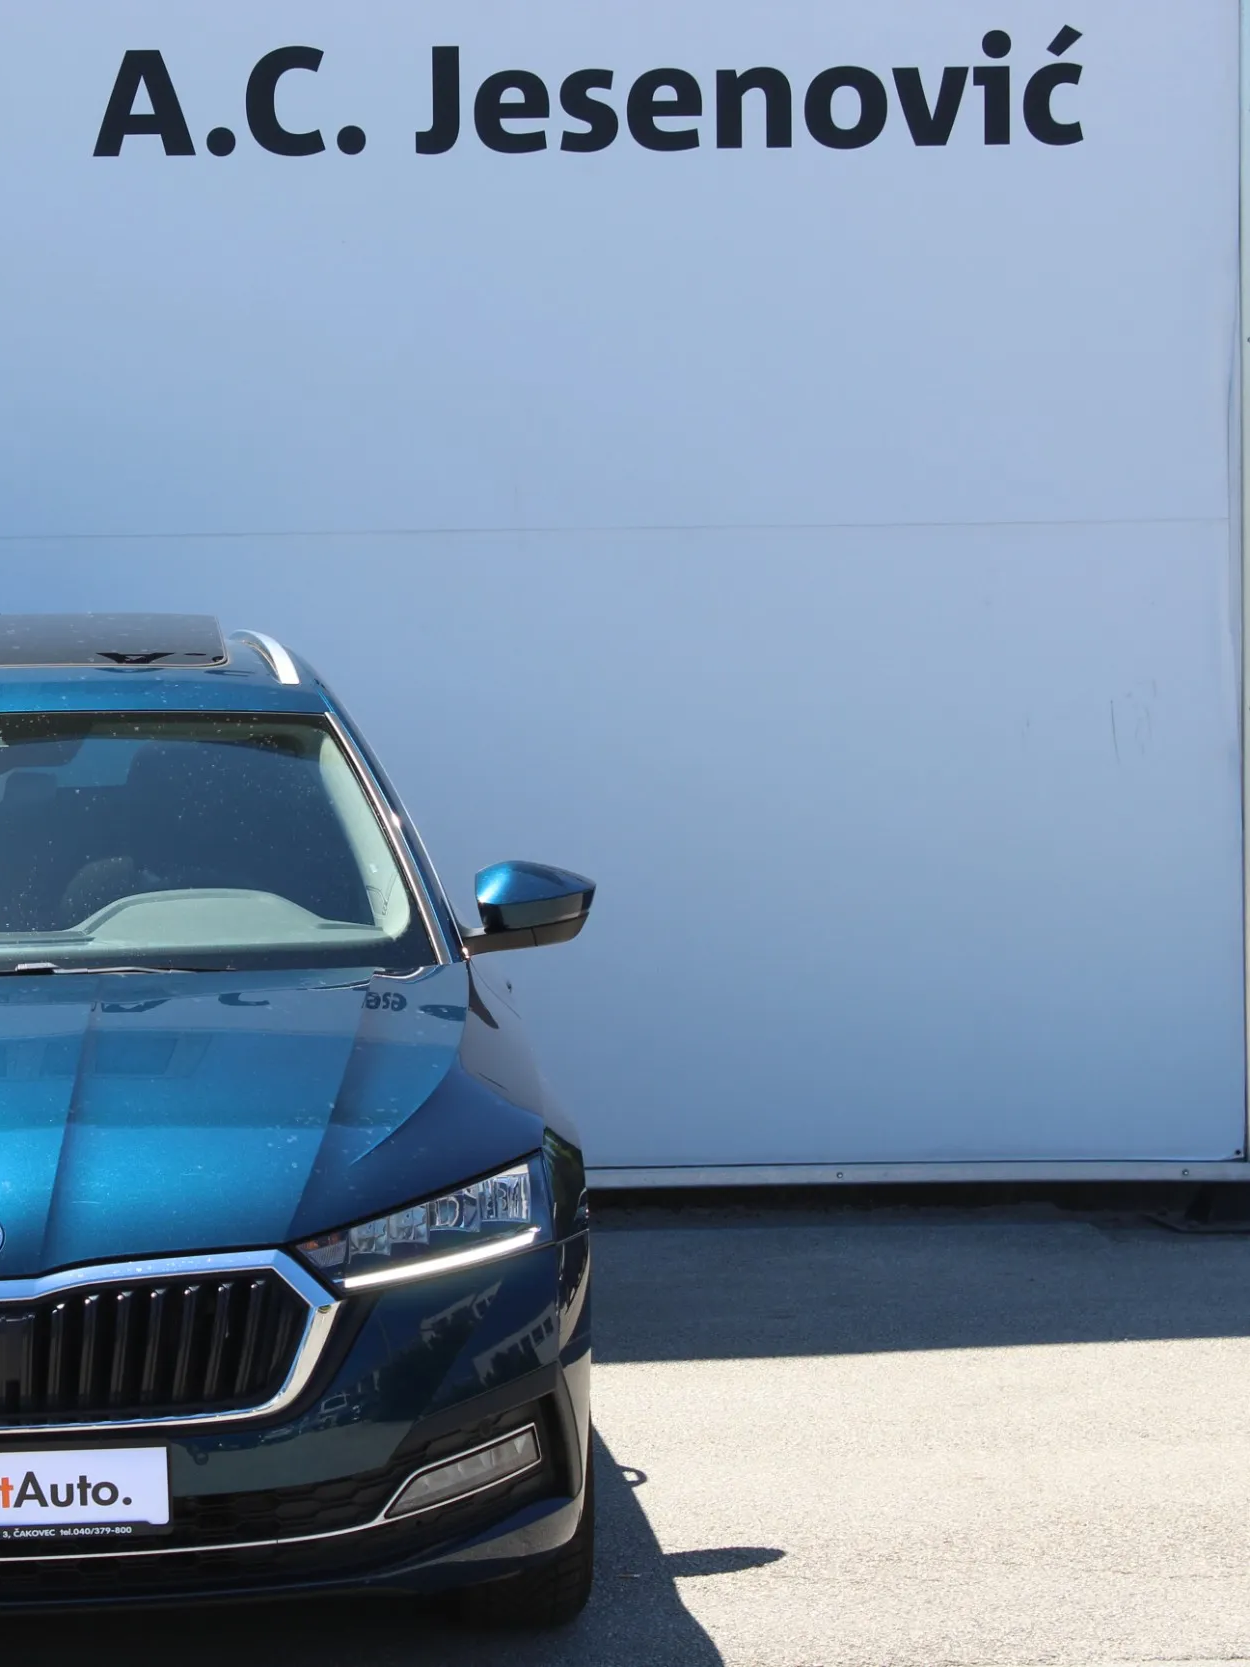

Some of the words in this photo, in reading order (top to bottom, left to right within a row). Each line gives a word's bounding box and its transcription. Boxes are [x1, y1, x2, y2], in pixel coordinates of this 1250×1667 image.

[92, 45, 367, 157] A.C.
[415, 24, 1084, 155] Jesenović
[13, 1528, 55, 1538] ČAKOVEC
